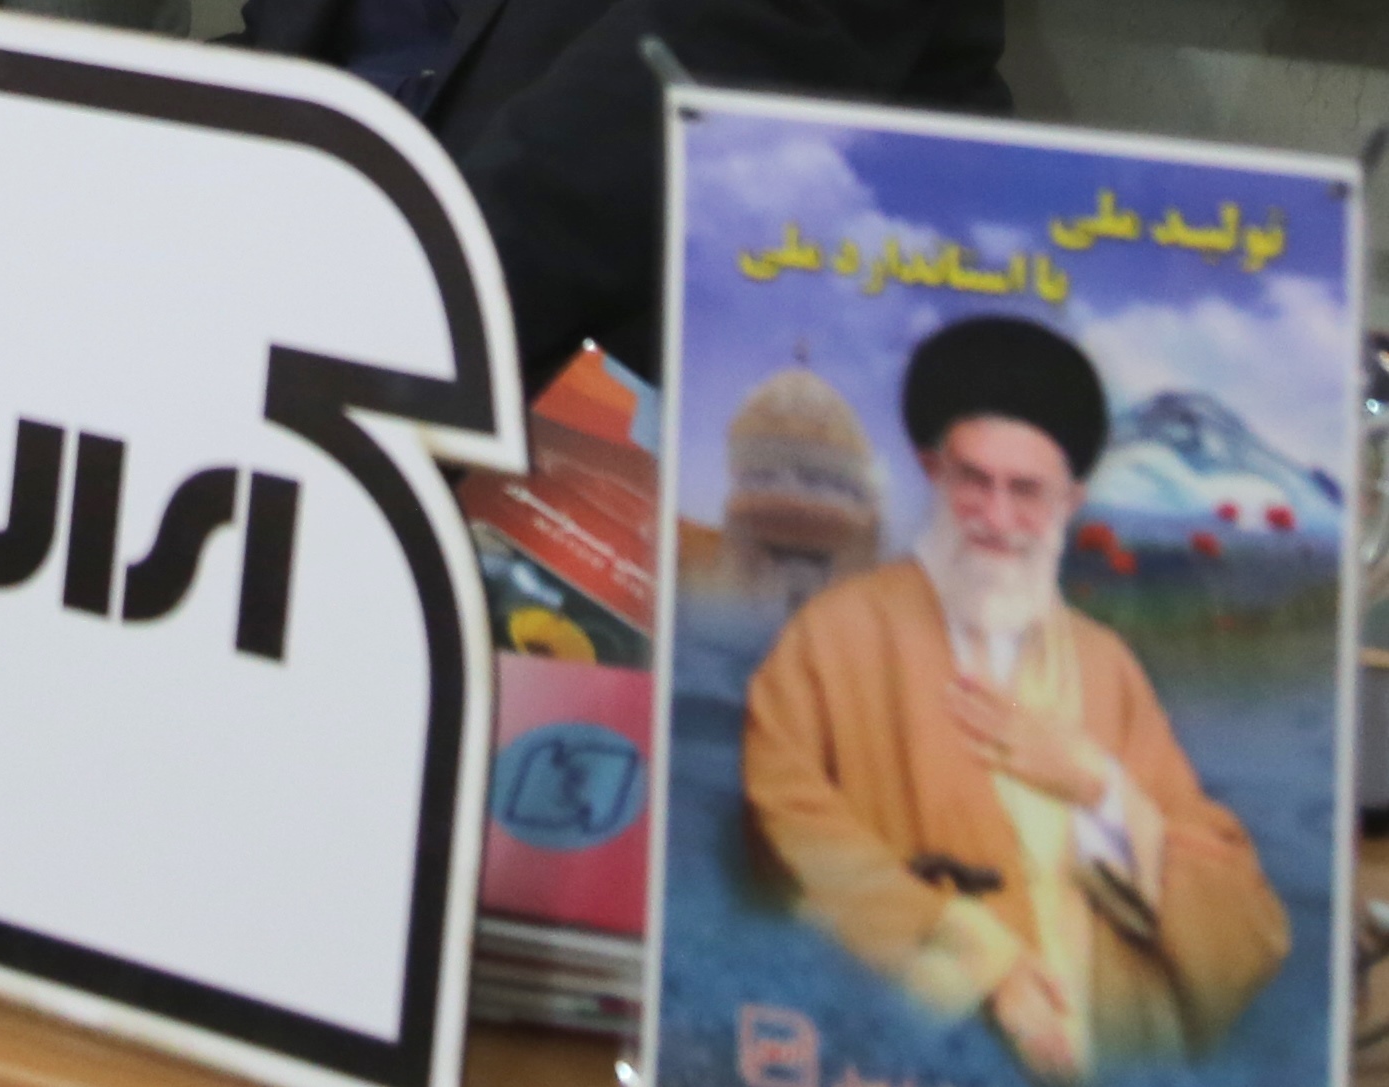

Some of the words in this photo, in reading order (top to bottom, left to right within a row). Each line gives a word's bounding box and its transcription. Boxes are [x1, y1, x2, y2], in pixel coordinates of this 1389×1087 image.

[1050, 188, 1140, 250] ملی
[1150, 201, 1286, 273] تولید
[738, 222, 822, 280] ملی
[832, 234, 1027, 296] استاندارد
